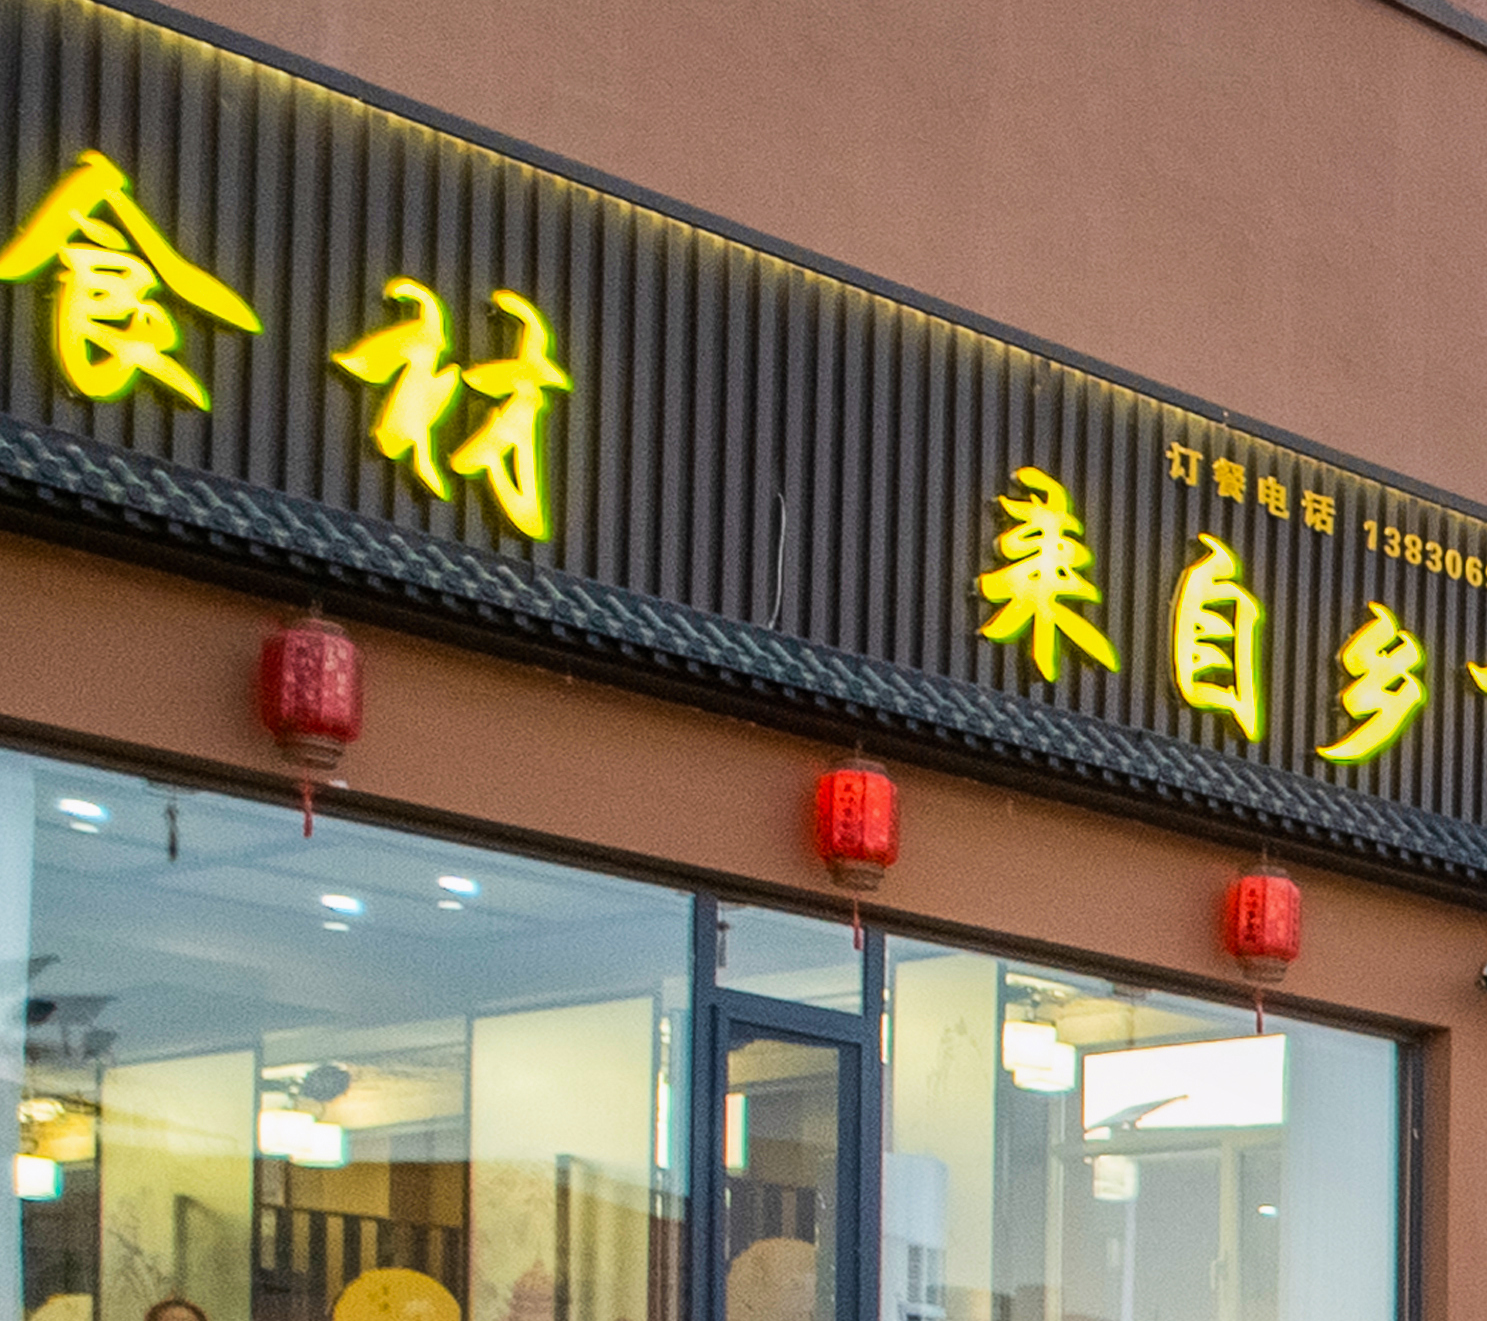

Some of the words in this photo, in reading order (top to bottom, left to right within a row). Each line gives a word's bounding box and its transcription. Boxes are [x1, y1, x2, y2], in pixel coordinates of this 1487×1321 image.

[0, 149, 573, 542] 食材
[1165, 441, 1337, 536] 订餐电话
